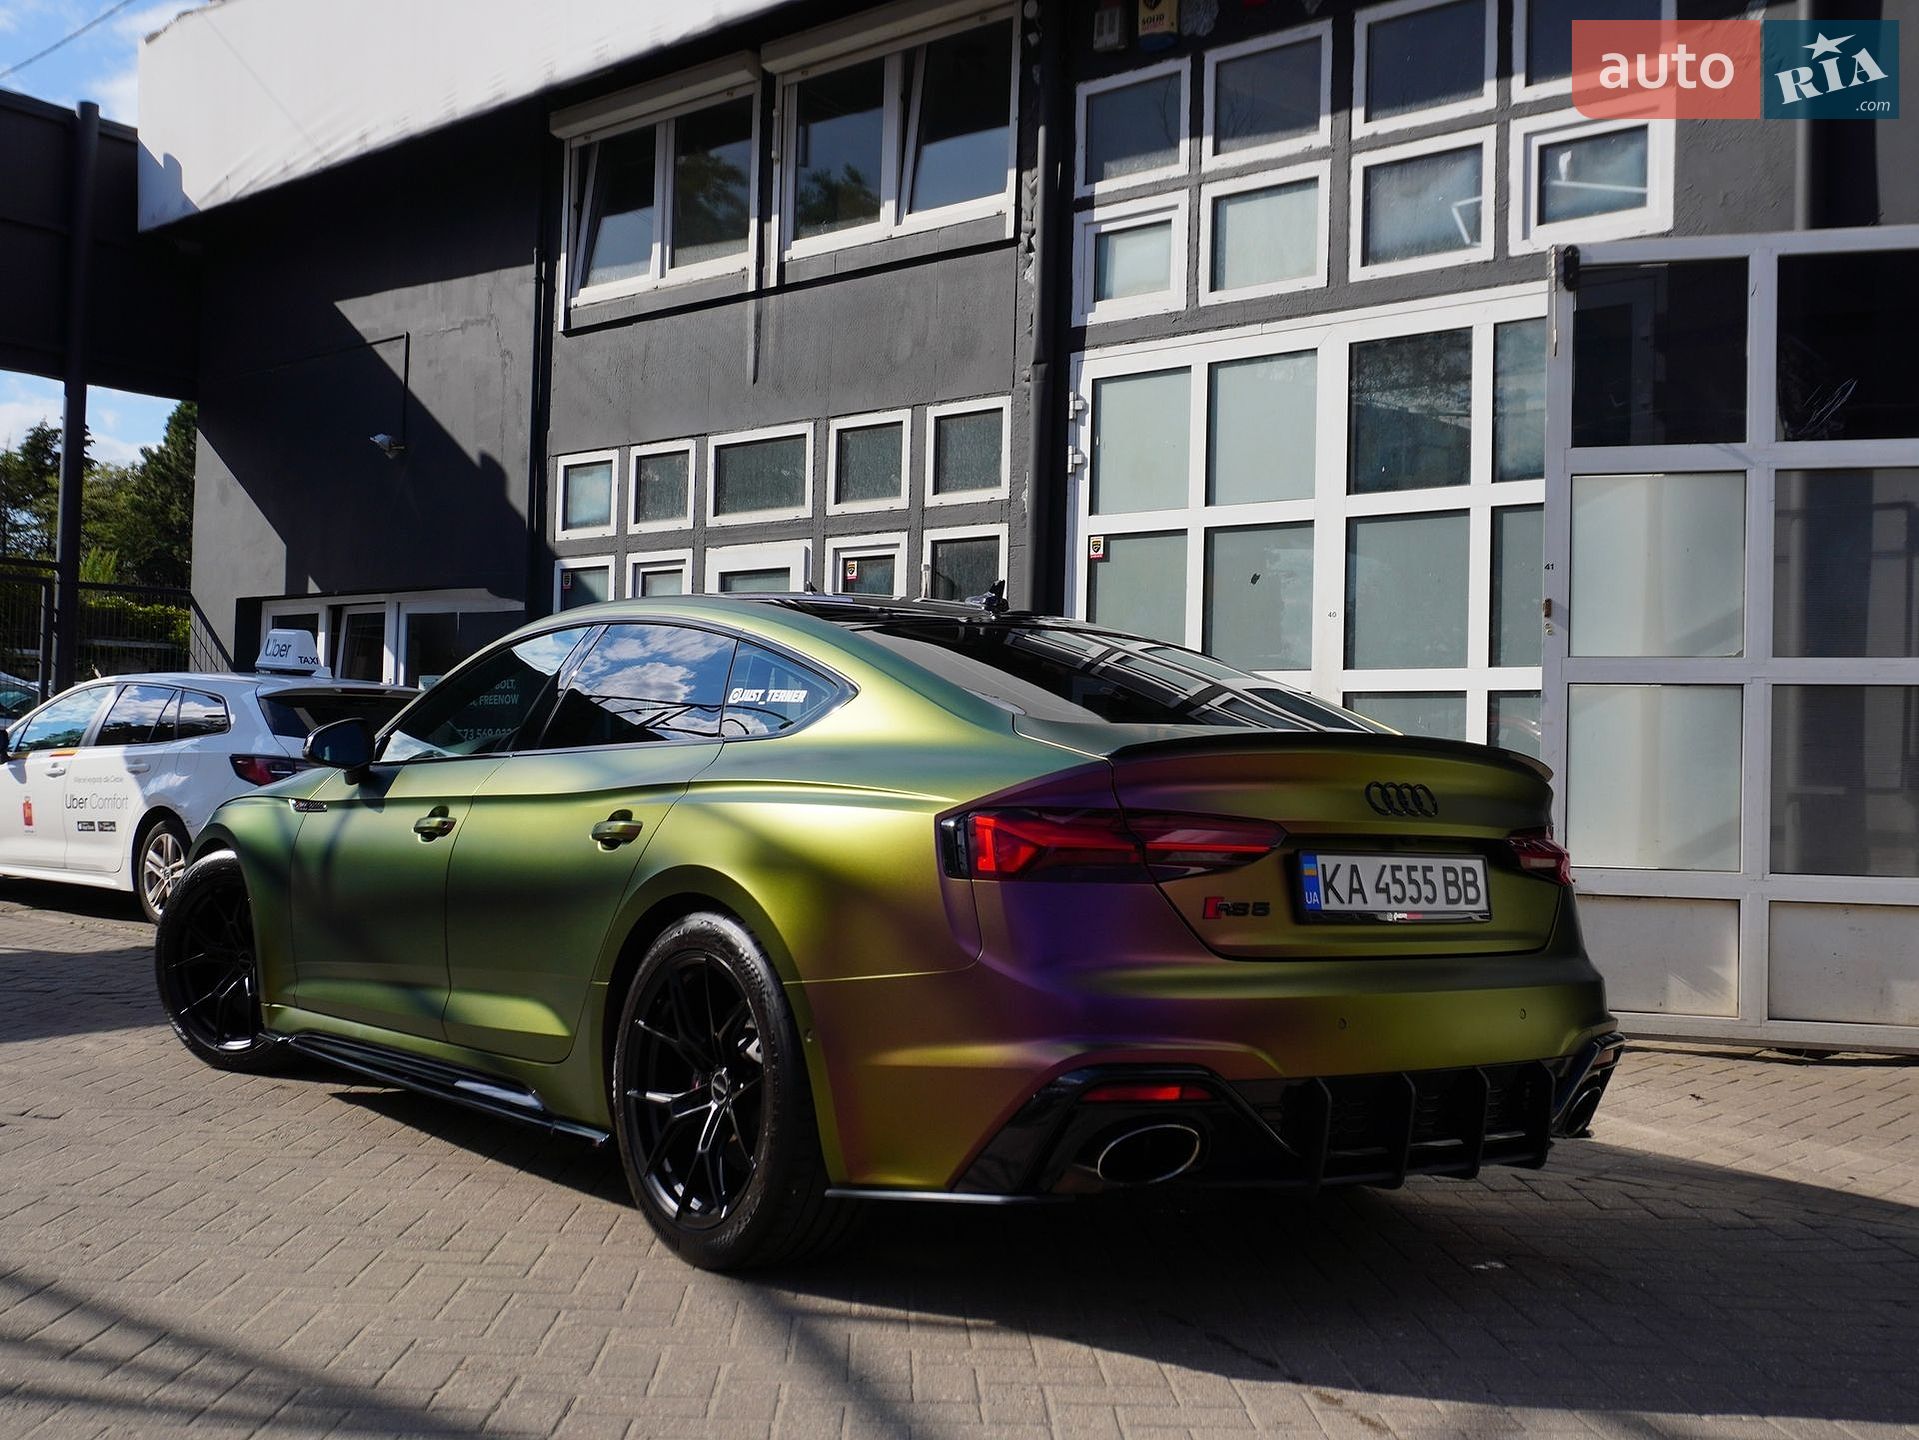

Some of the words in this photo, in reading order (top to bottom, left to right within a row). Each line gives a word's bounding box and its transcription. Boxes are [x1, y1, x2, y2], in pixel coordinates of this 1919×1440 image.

[264, 638, 292, 658] Uber
[297, 655, 320, 665] TAXI
[479, 694, 519, 706] FREENOW
[65, 793, 88, 810] Uber
[89, 792, 129, 810] Comfort
[1320, 863, 1368, 905] KA
[1374, 864, 1438, 905] 4555
[1441, 865, 1482, 906] BB
[1305, 891, 1320, 905] UA
